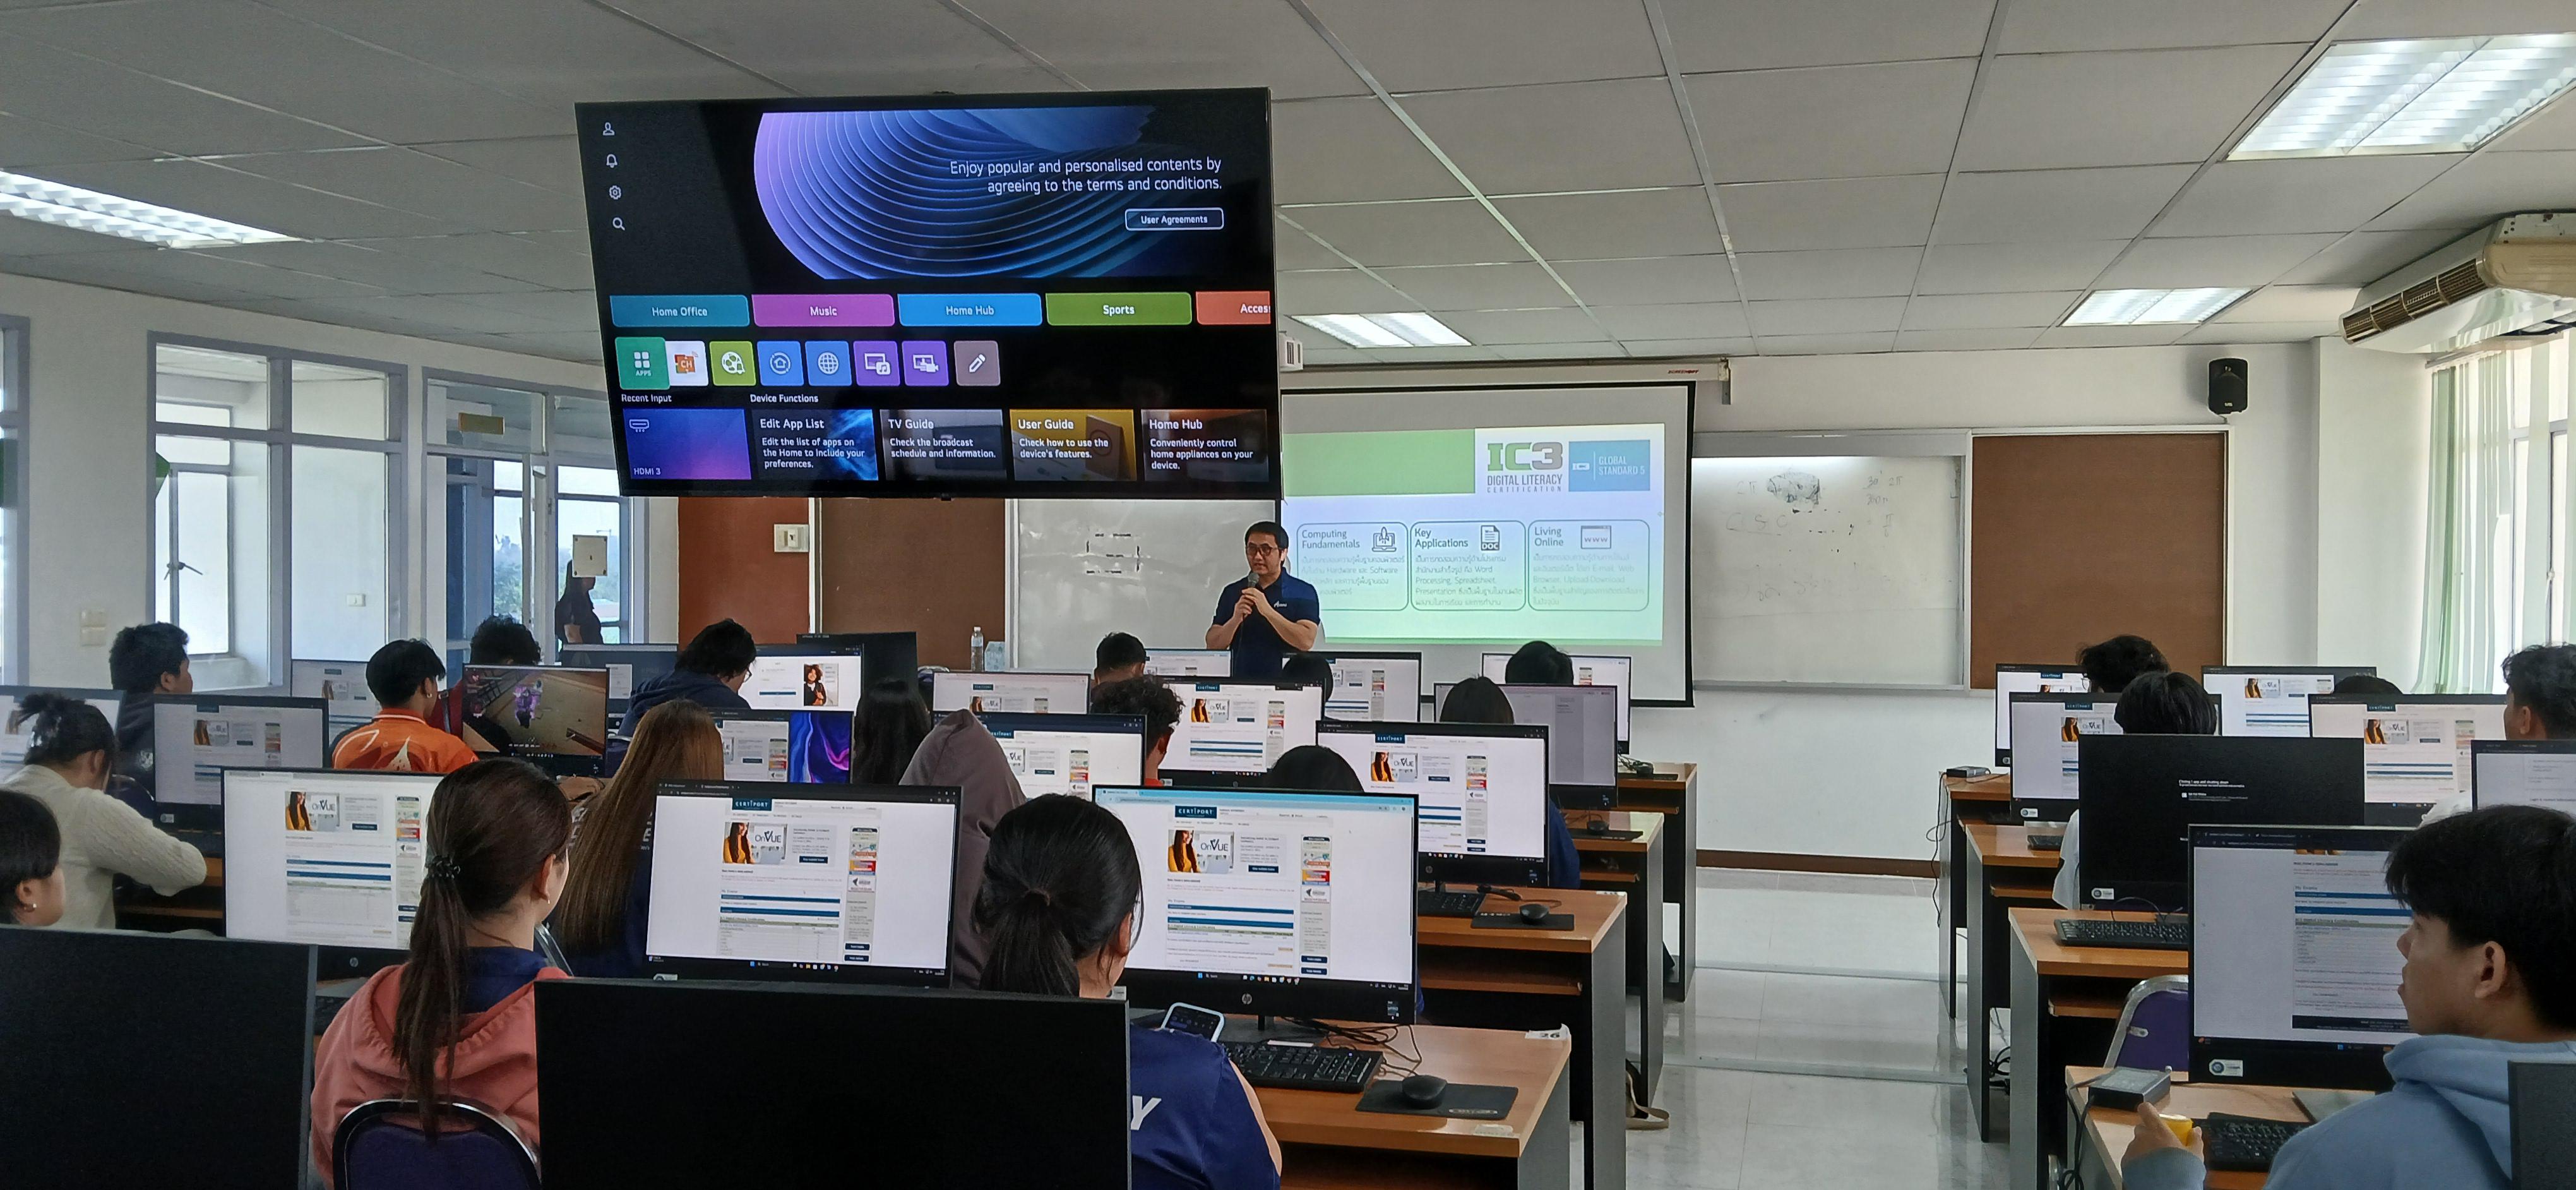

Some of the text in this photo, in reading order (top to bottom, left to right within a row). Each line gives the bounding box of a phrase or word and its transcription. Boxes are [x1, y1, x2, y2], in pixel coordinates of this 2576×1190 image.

[950, 157, 1221, 176] Enjoy popular and personalised contents by
[987, 177, 1222, 195] agreeing to the terms and conditions.
[1141, 215, 1208, 225] User Agreements
[652, 306, 707, 316] Home Office
[810, 306, 837, 316] Music
[946, 305, 994, 315] Home Hub
[1103, 305, 1135, 316] Sports
[681, 360, 693, 368] CH
[621, 394, 672, 404] Recent Input
[750, 394, 819, 403] Device Functions
[760, 419, 824, 431] Edit App List
[888, 419, 934, 430] TV Guide
[1018, 419, 1073, 430] User Guide
[1149, 419, 1203, 430] Home Hub
[761, 438, 778, 446] Edit
[780, 438, 794, 446] the
[796, 437, 810, 446] list
[811, 438, 821, 446] of
[823, 439, 842, 448] apps
[890, 438, 974, 447] Check the broadcast
[1019, 438, 1044, 447] Check
[1046, 438, 1064, 447] how
[1066, 440, 1075, 448] to
[1094, 439, 1108, 448] the
[1150, 438, 1237, 450] Conveniently control
[763, 449, 777, 458] the
[779, 448, 802, 457] Home
[816, 448, 844, 457] include
[846, 450, 865, 459] your
[891, 449, 996, 459] schedule and information.
[1020, 450, 1092, 459] device's features.
[1151, 450, 1174, 459] home
[1176, 450, 1220, 462] appliances
[1234, 452, 1253, 462] your
[1488, 442, 1563, 471] IC3
[764, 460, 814, 470] preferences.
[1599, 456, 1627, 465] GLOBAL
[1151, 461, 1180, 471] device.
[1599, 466, 1645, 475] STANDARD 5
[633, 467, 653, 476] HDMI
[1488, 474, 1562, 485] DIGITAL LITERACY
[1302, 530, 1347, 539] Computing
[1415, 528, 1431, 538] Key
[1535, 527, 1561, 537] Living
[1303, 540, 1360, 548] Fundamentals
[1415, 539, 1468, 549] Applications
[1535, 538, 1563, 546] Online
[755, 831, 781, 843] OnVUE
[1201, 839, 1228, 851] OnVUE
